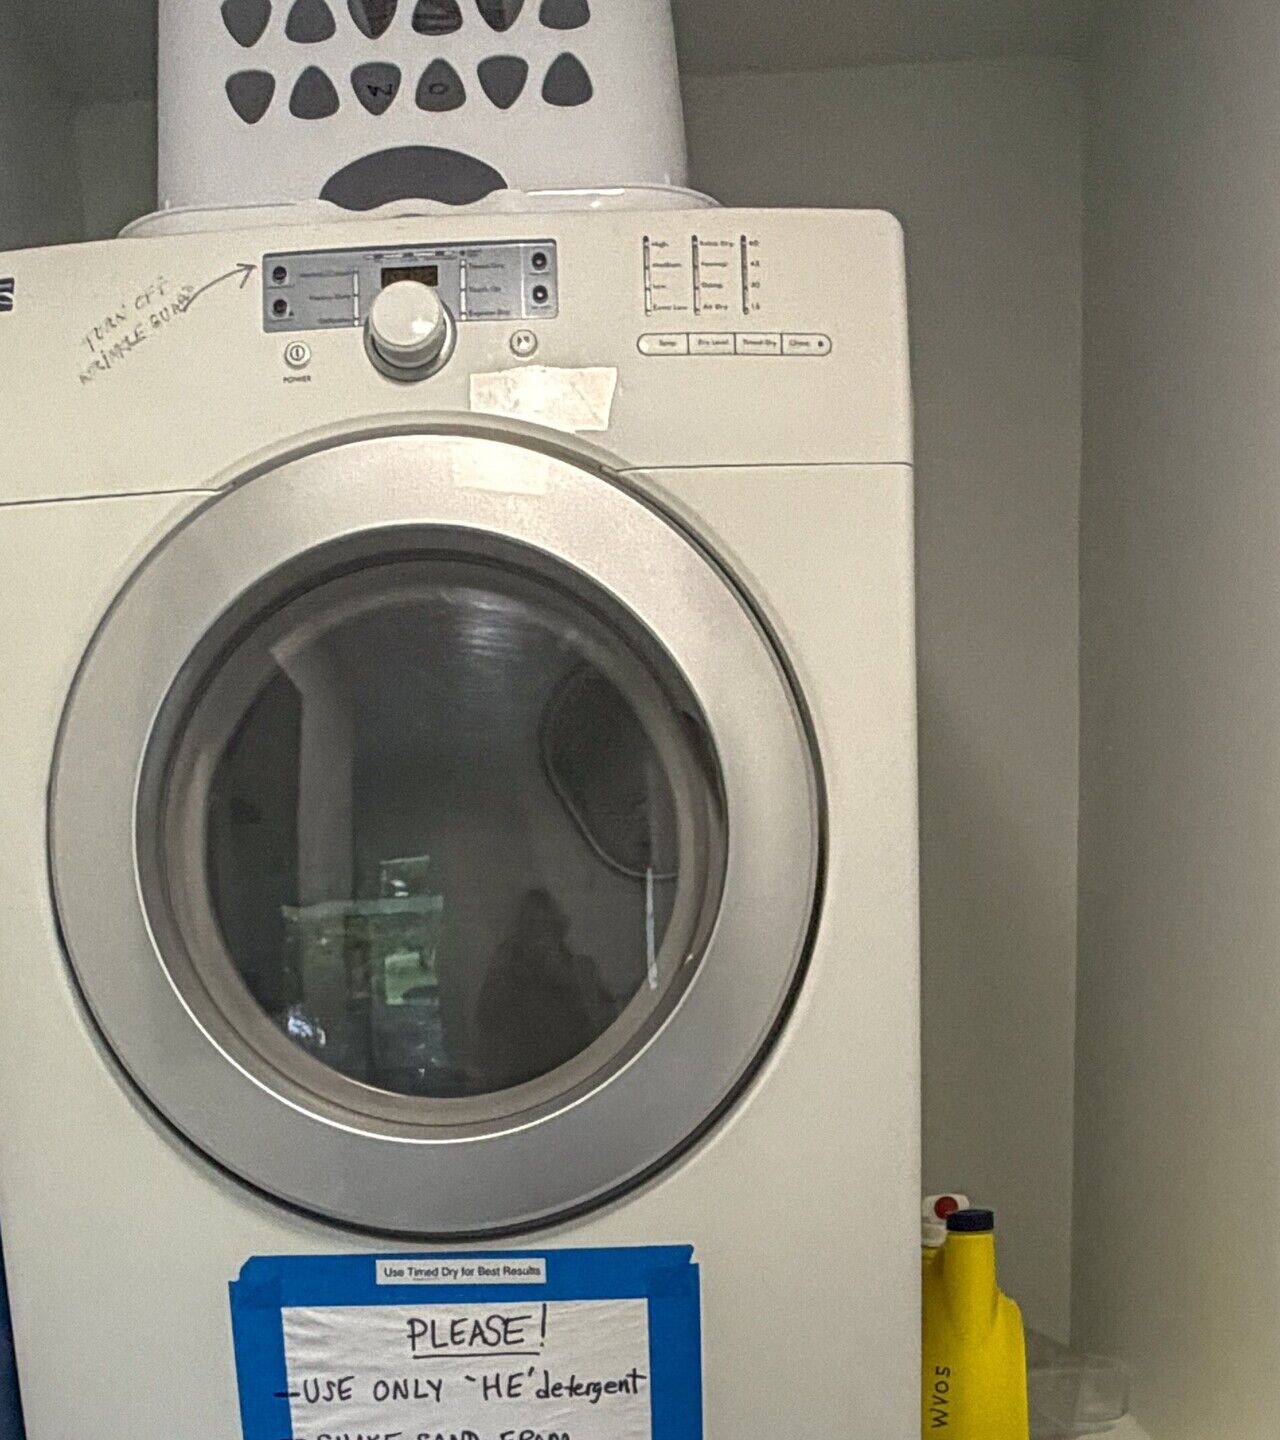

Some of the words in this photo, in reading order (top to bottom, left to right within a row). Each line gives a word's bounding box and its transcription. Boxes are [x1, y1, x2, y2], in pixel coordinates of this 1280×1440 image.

[384, 1267, 404, 1278] Use
[407, 1266, 438, 1278] Timed
[441, 1266, 459, 1280] Dry
[461, 1266, 475, 1277] for
[477, 1265, 501, 1277] Best
[502, 1265, 542, 1277] Results
[372, 1378, 443, 1403] ONLY
[535, 1367, 647, 1404] detergent
